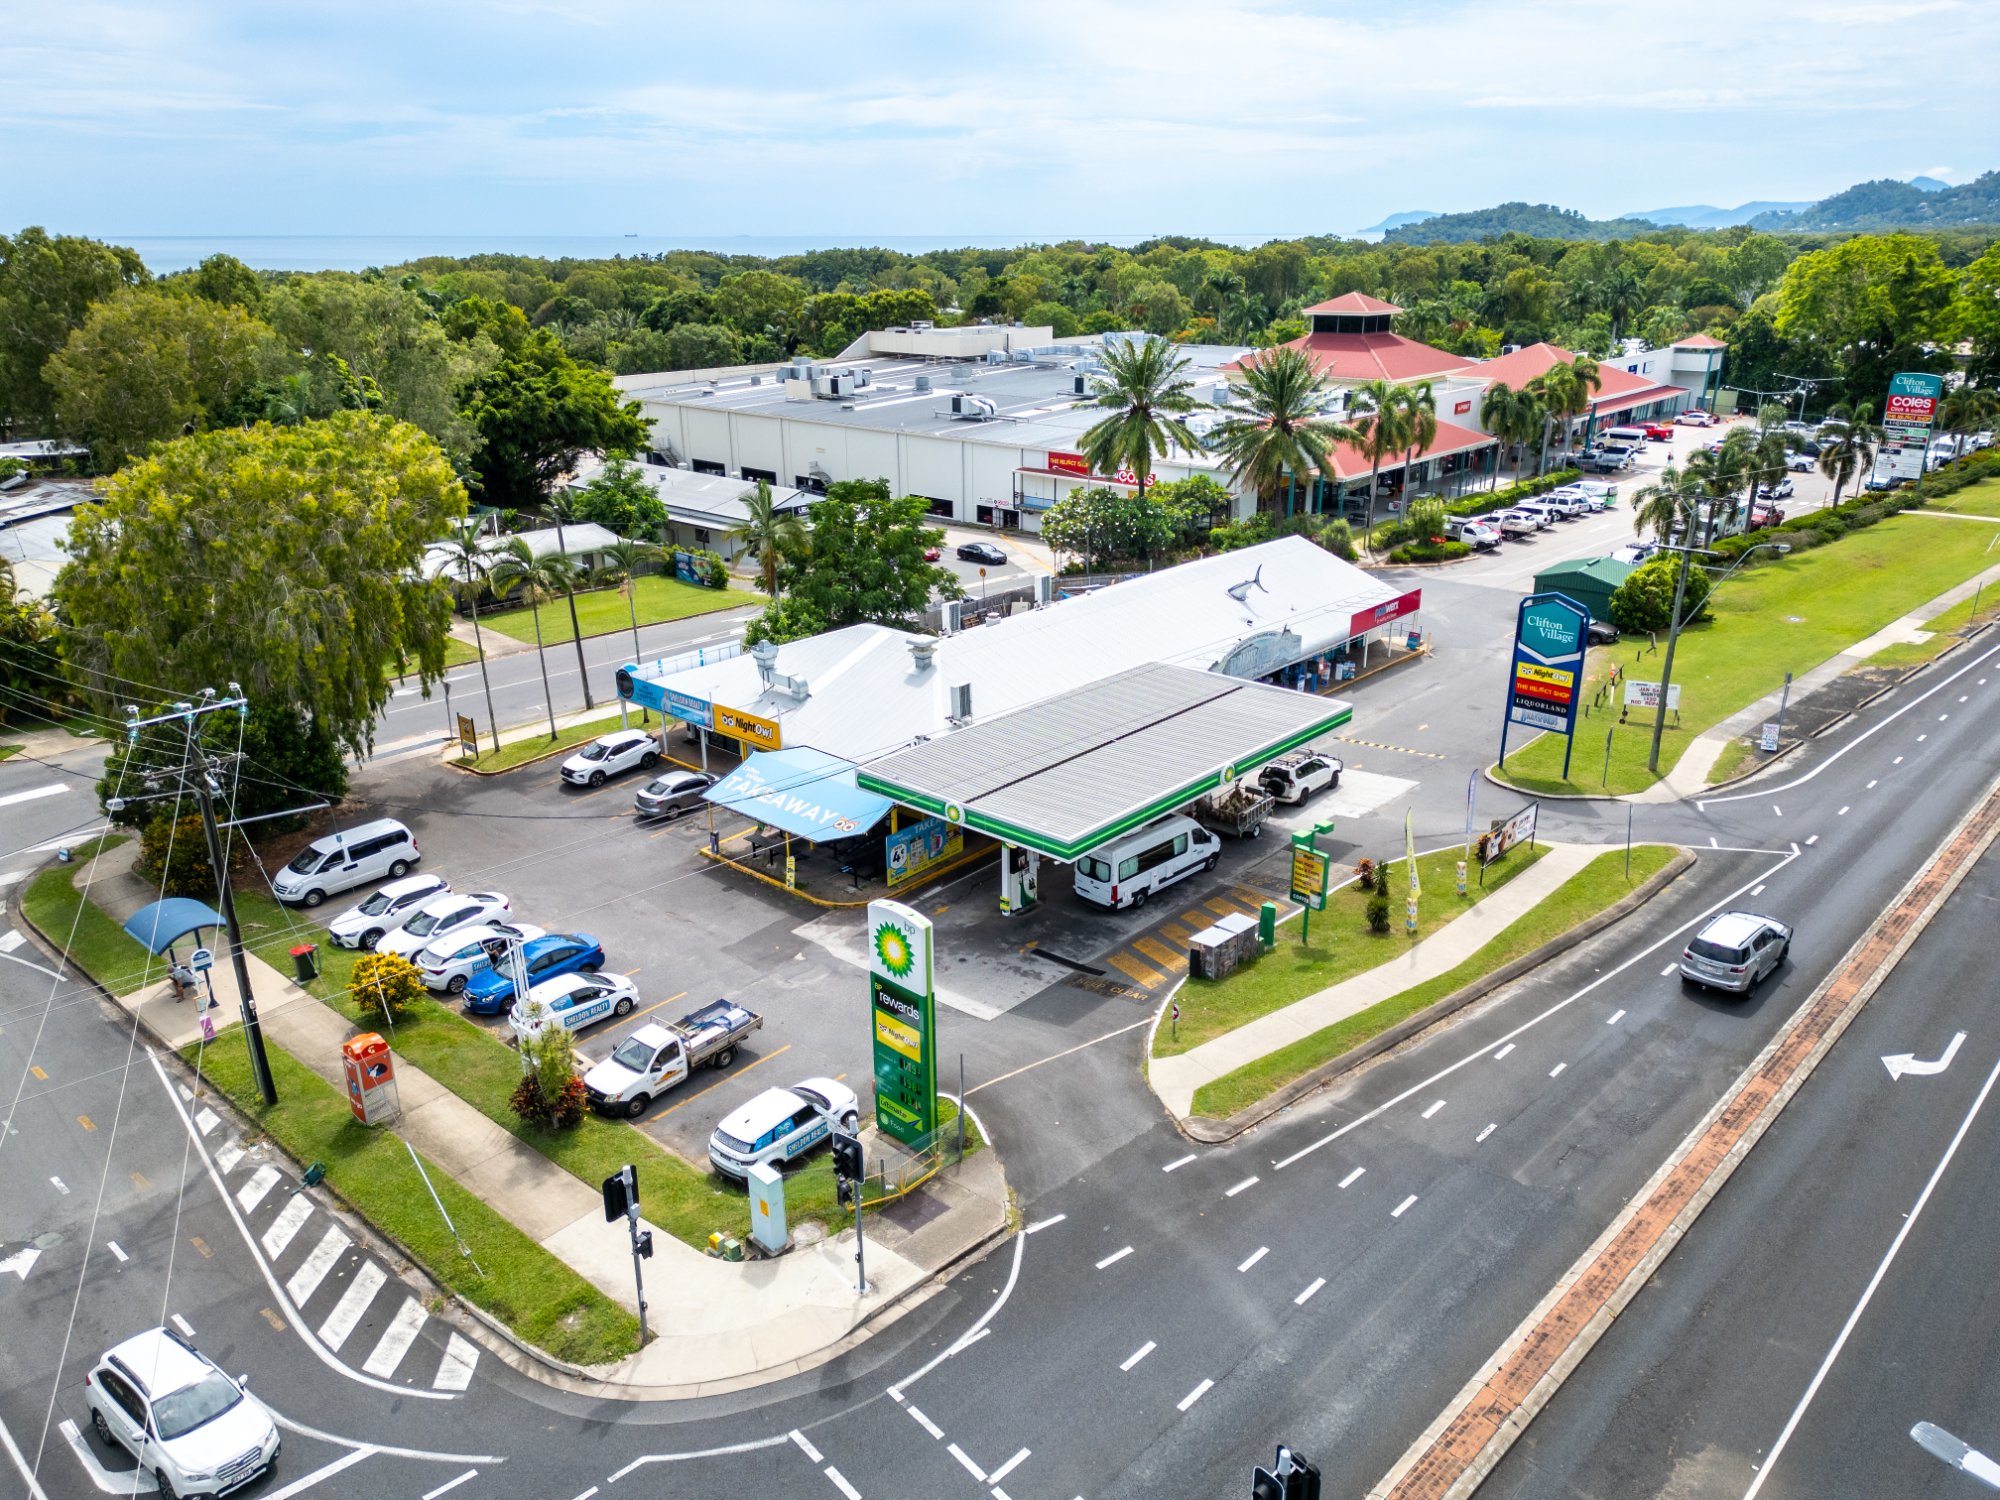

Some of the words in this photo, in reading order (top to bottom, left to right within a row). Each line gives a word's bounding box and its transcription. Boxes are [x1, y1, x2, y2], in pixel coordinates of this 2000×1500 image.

[1896, 376, 1926, 386] Clifton
[1905, 385, 1934, 396] Village
[1527, 615, 1563, 630] Clifton
[1539, 627, 1574, 643] Village
[1516, 682, 1528, 690] THE
[1529, 685, 1553, 695] REJECT
[1553, 690, 1570, 699] SHOP
[1516, 697, 1567, 713] LIQUORLAND
[735, 717, 773, 739] NightOwl
[725, 775, 839, 825] TAKEAWAY
[904, 920, 916, 935] bp
[879, 991, 920, 1020] rewards
[890, 1119, 905, 1133] Food
[788, 1135, 811, 1155] SHELDON
